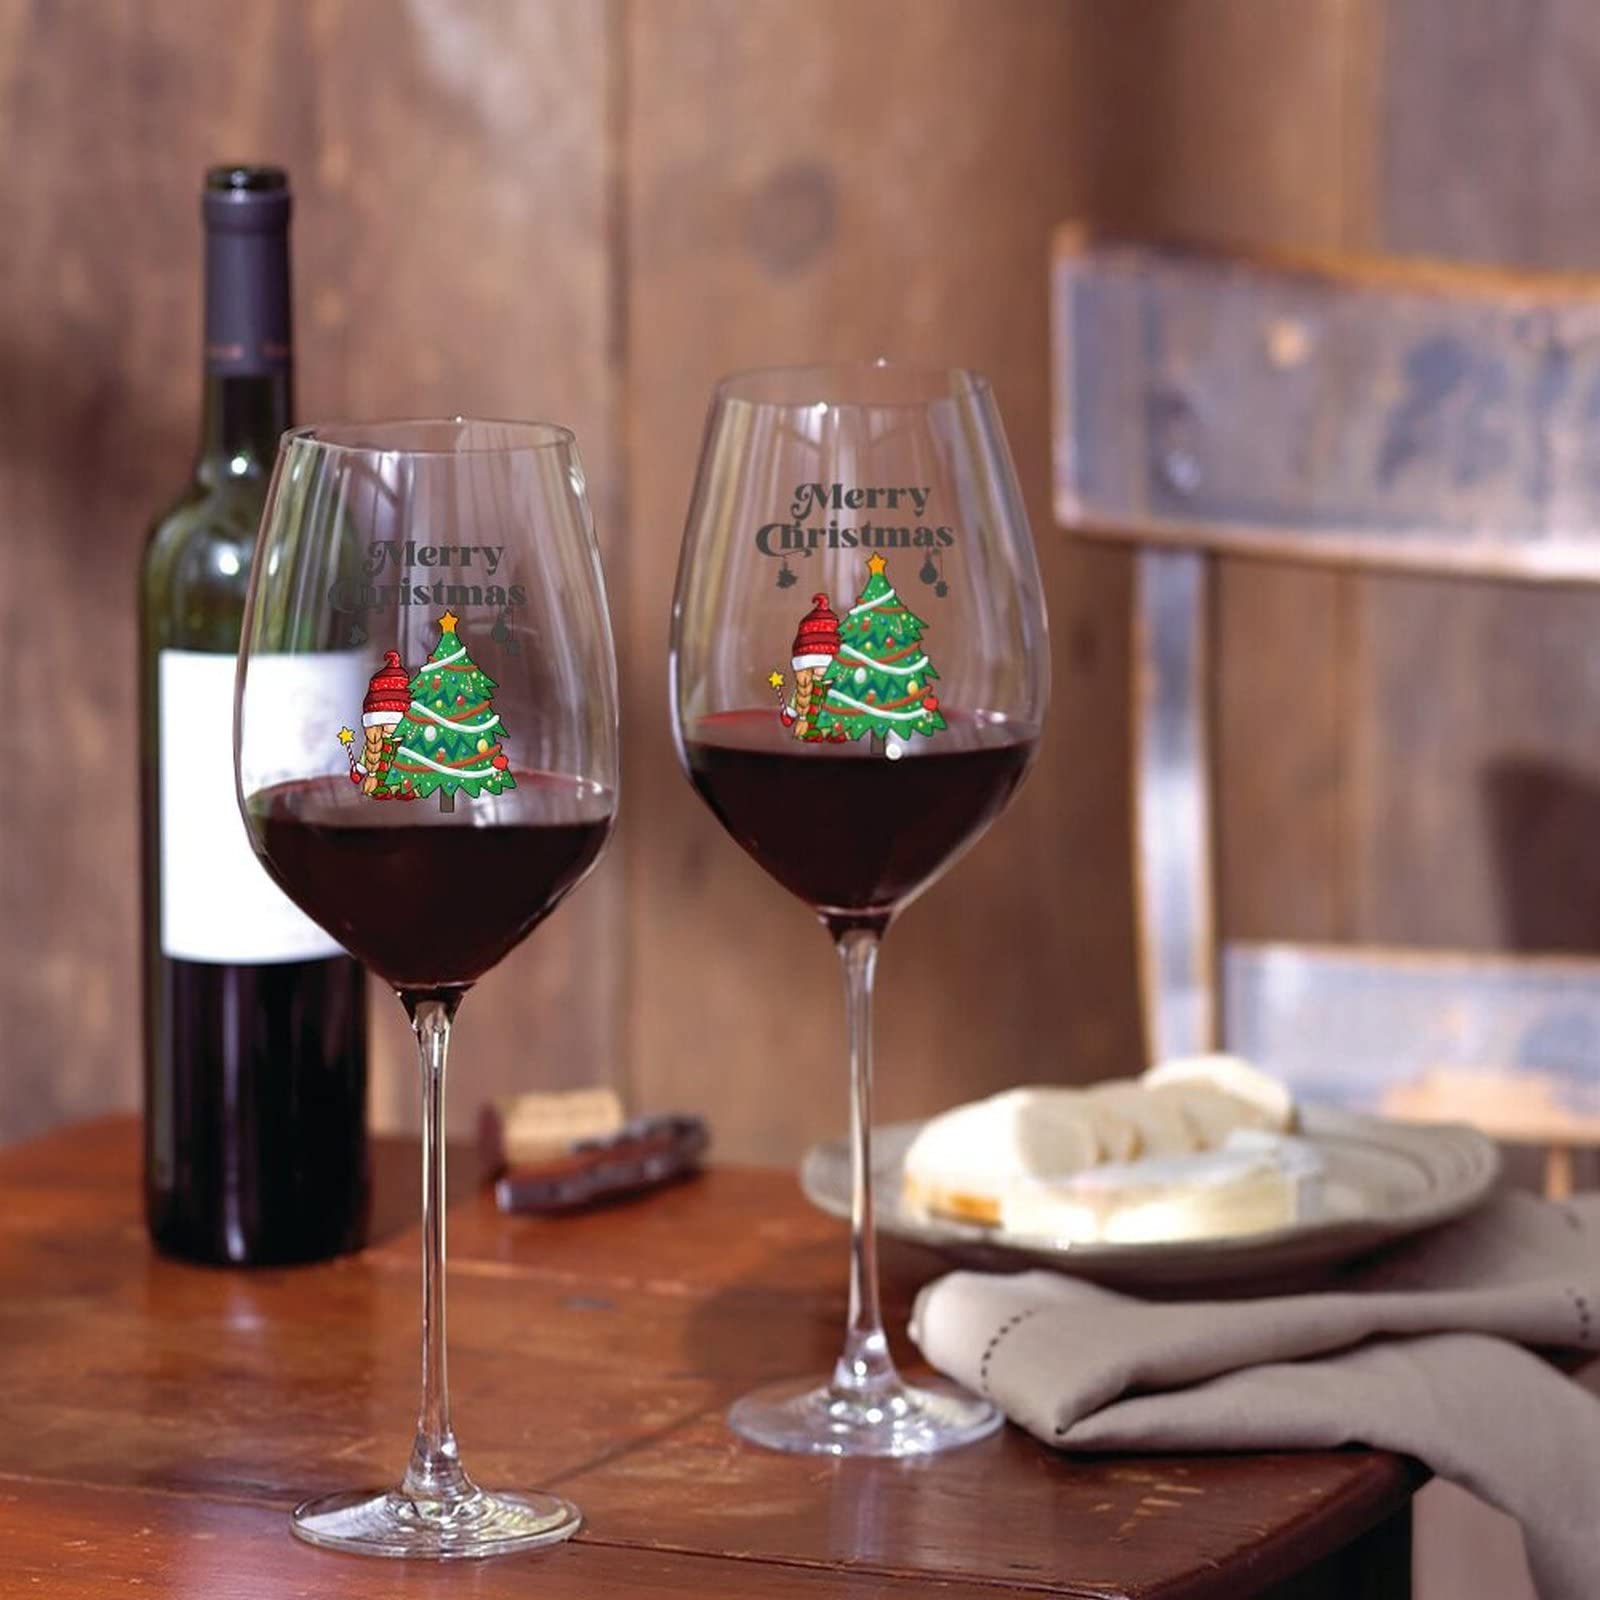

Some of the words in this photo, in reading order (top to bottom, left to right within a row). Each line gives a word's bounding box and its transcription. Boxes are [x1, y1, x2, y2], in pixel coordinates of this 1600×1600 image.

[791, 483, 930, 520] Merry
[755, 520, 955, 557] Christmas
[364, 541, 504, 577] Merry
[327, 578, 527, 613] Christmas
